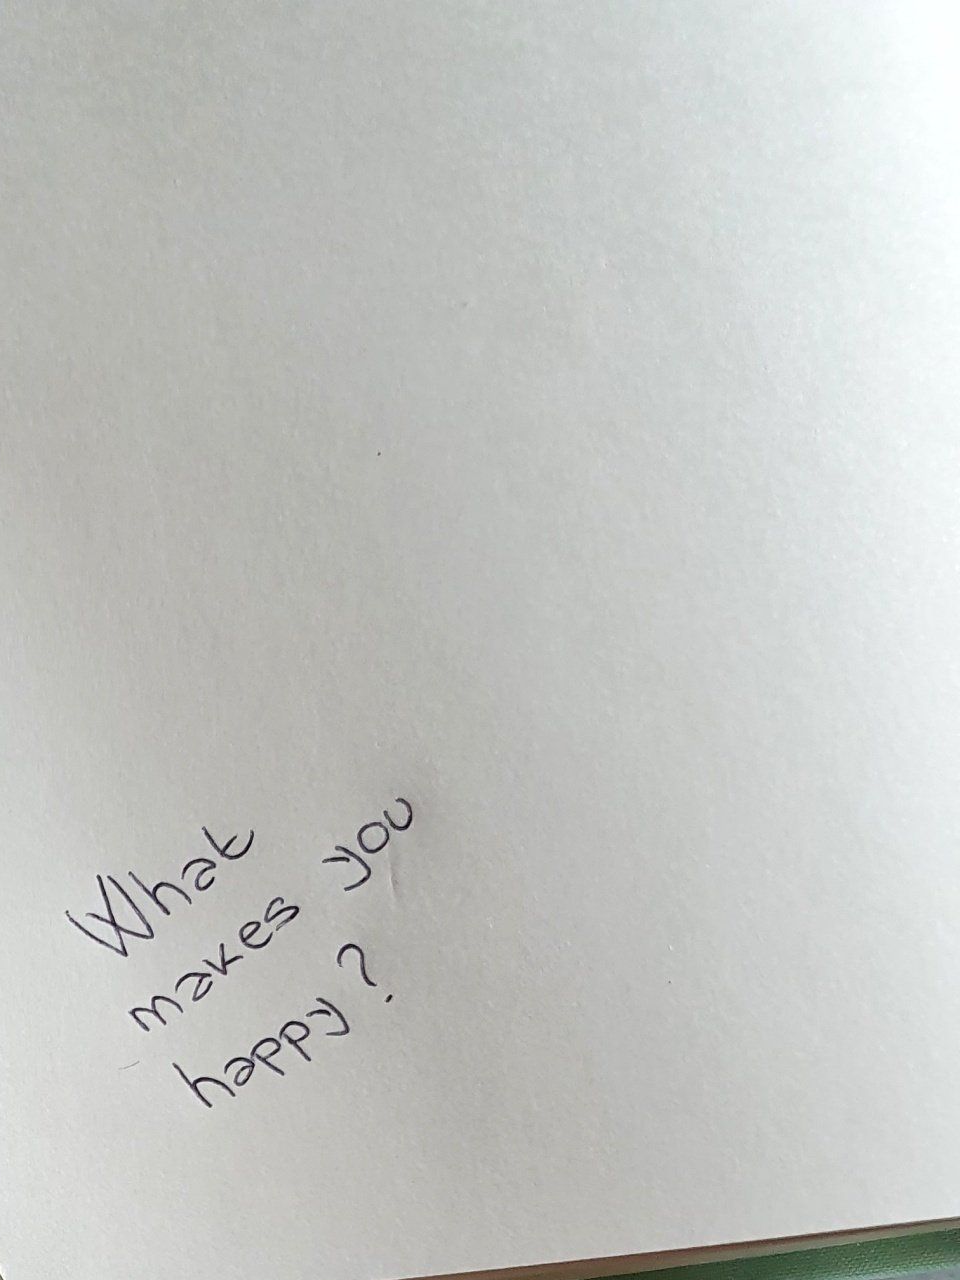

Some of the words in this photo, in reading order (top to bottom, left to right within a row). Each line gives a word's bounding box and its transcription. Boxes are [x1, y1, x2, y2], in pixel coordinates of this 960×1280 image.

[65, 826, 254, 957] What
[129, 897, 300, 1032] makes
[322, 797, 413, 892] you
